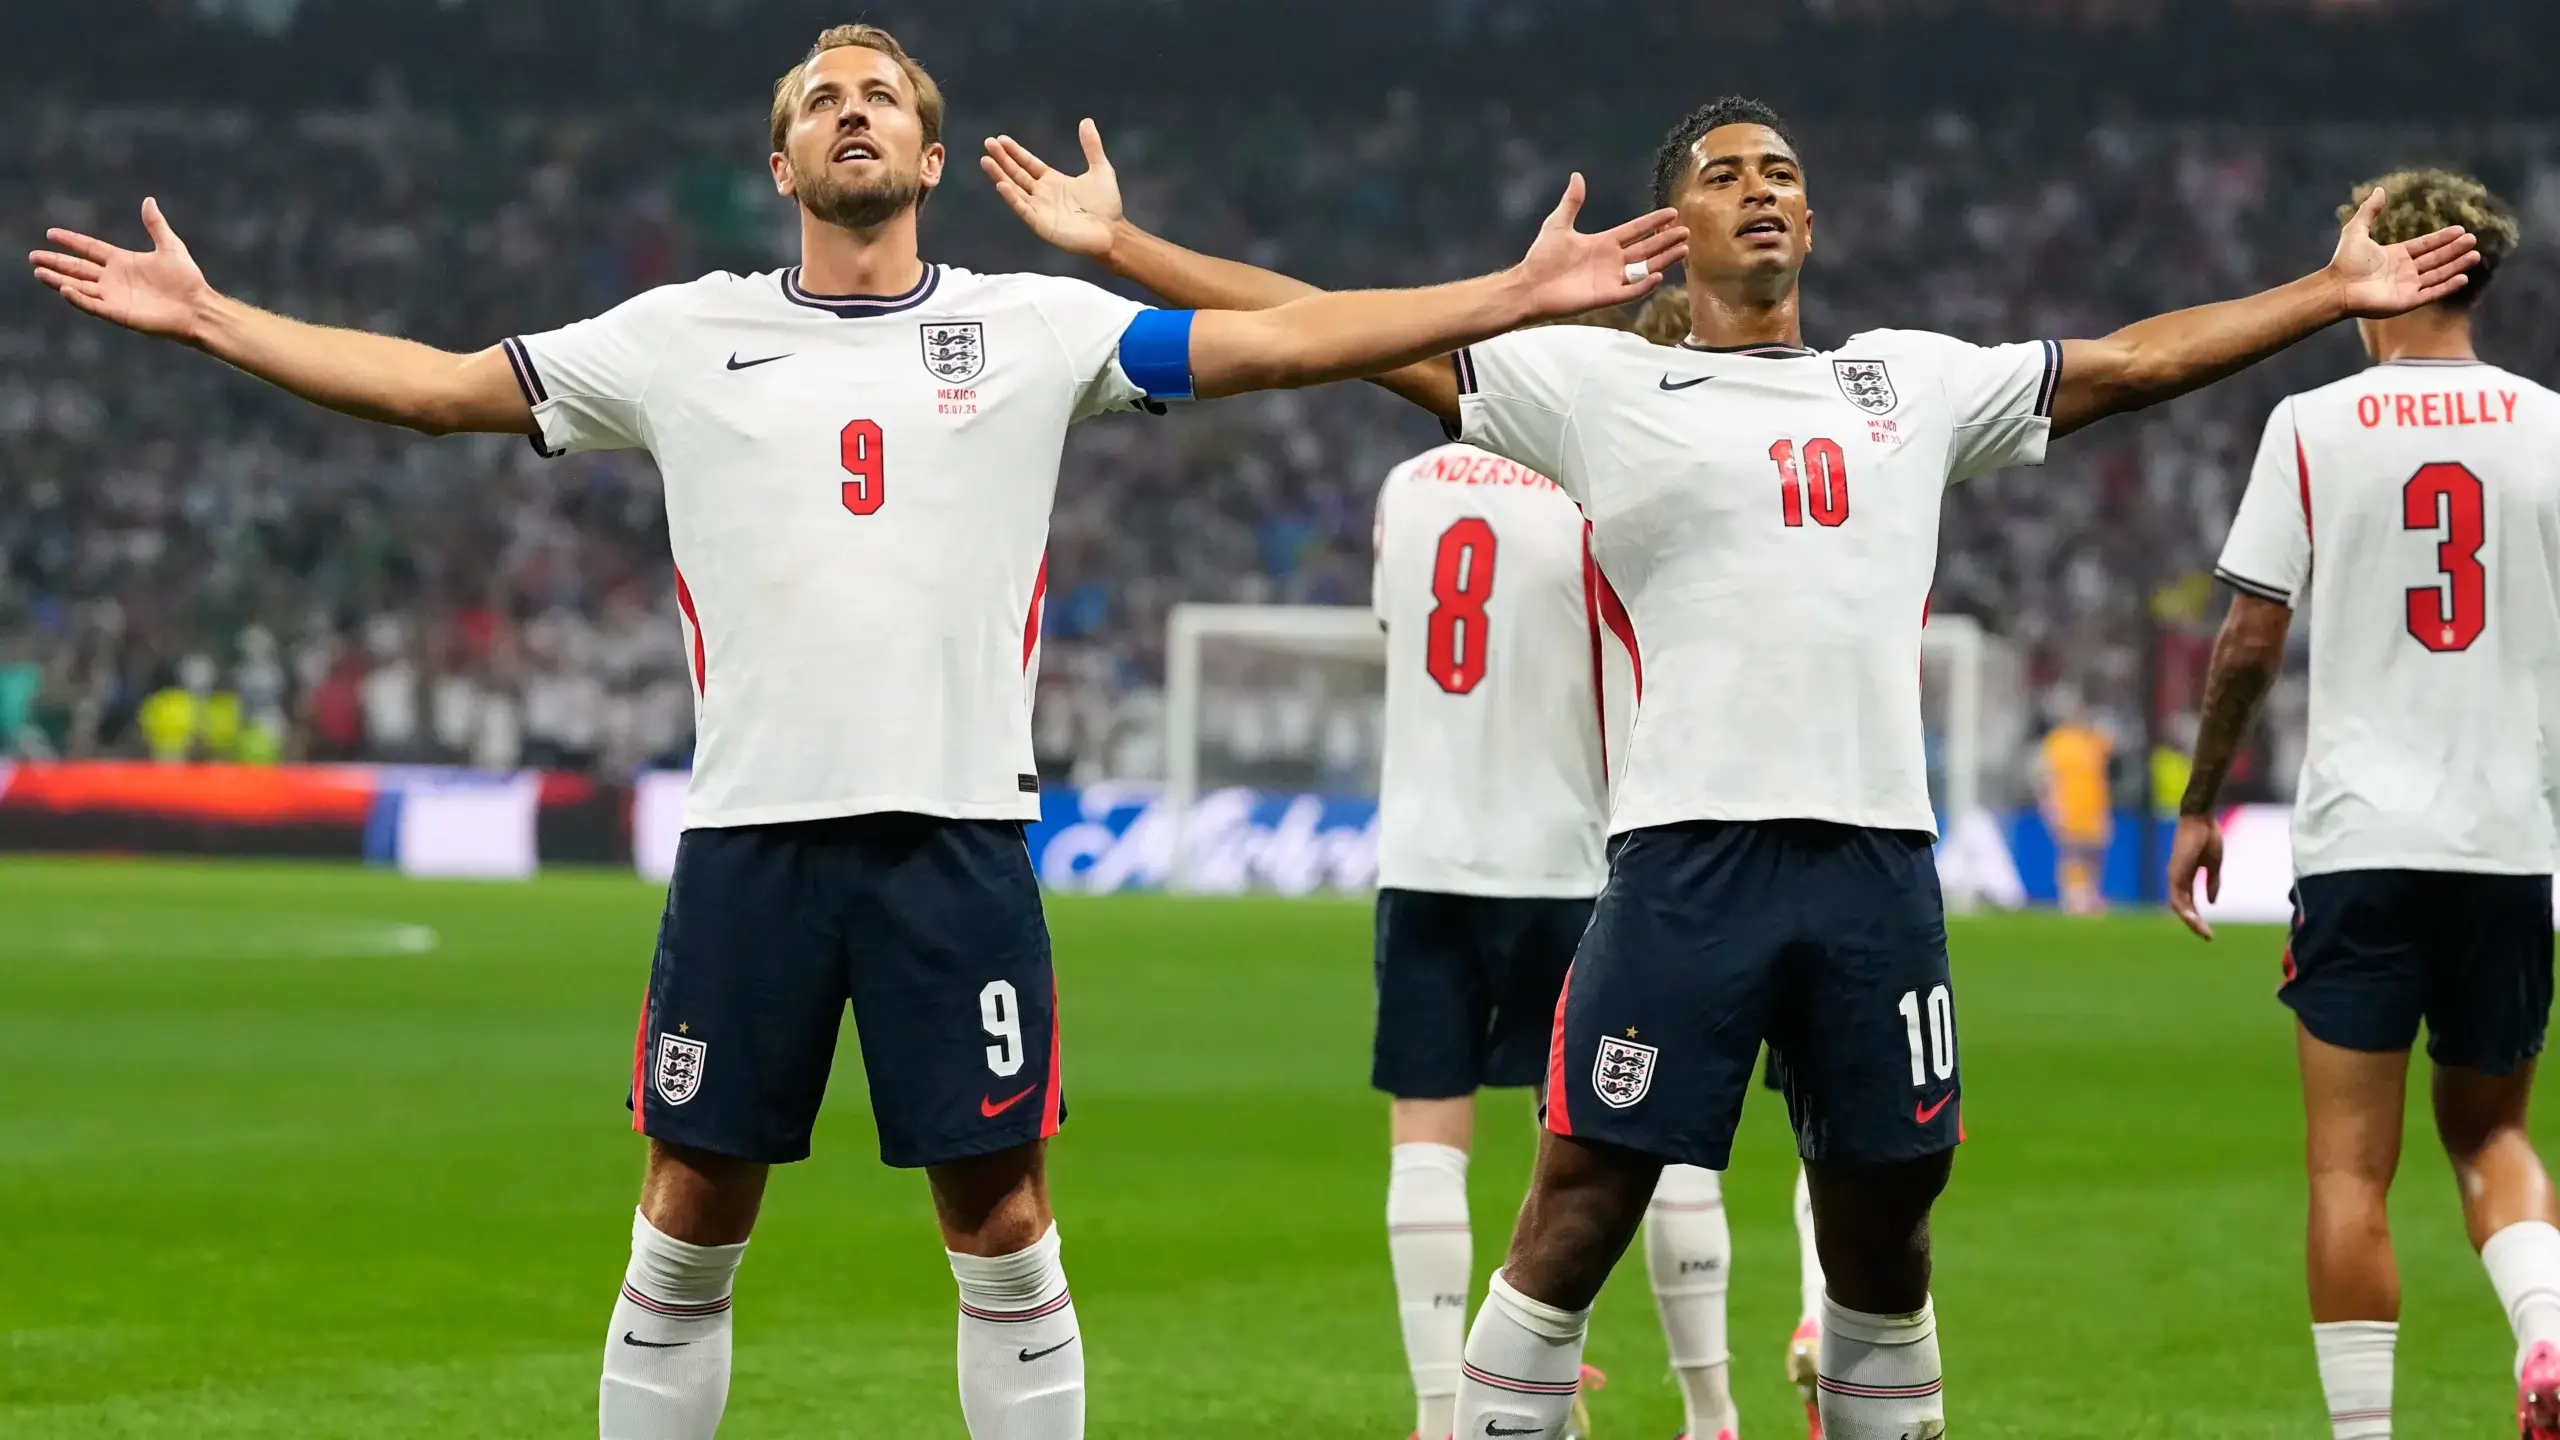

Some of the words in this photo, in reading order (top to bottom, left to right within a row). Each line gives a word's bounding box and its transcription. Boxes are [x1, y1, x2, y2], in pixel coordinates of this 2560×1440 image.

[937, 388, 977, 400] MEXICO
[2357, 389, 2518, 428] O'REILLY
[840, 419, 885, 515] 9
[1768, 438, 1849, 527] 10
[1426, 516, 1498, 694] 8
[2402, 461, 2486, 653] 3
[979, 979, 1025, 1078] 9
[1898, 983, 1954, 1087] 10
